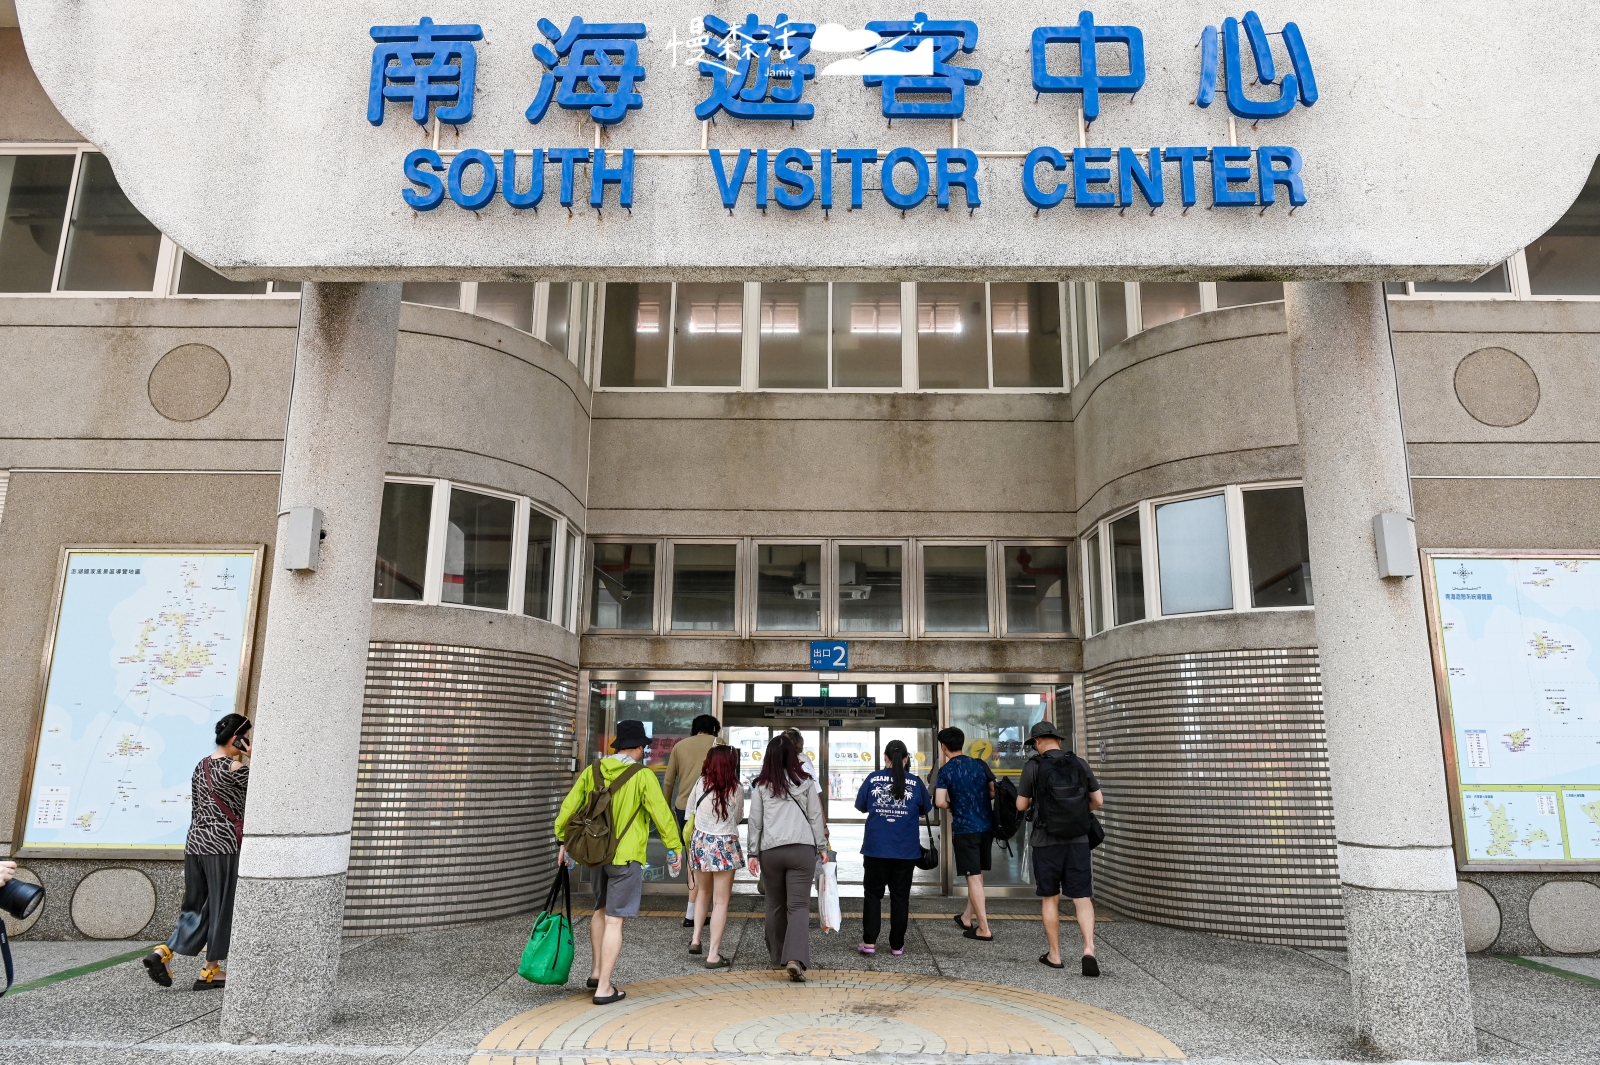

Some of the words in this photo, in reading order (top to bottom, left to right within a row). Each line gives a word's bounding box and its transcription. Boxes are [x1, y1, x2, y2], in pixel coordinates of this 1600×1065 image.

[367, 10, 1319, 126] 南海遊客中心
[402, 148, 634, 211] SOUTH
[708, 147, 981, 210] VISITOR
[1022, 146, 1307, 209] CENTER
[813, 649, 831, 658] 出口
[832, 646, 846, 667] 2
